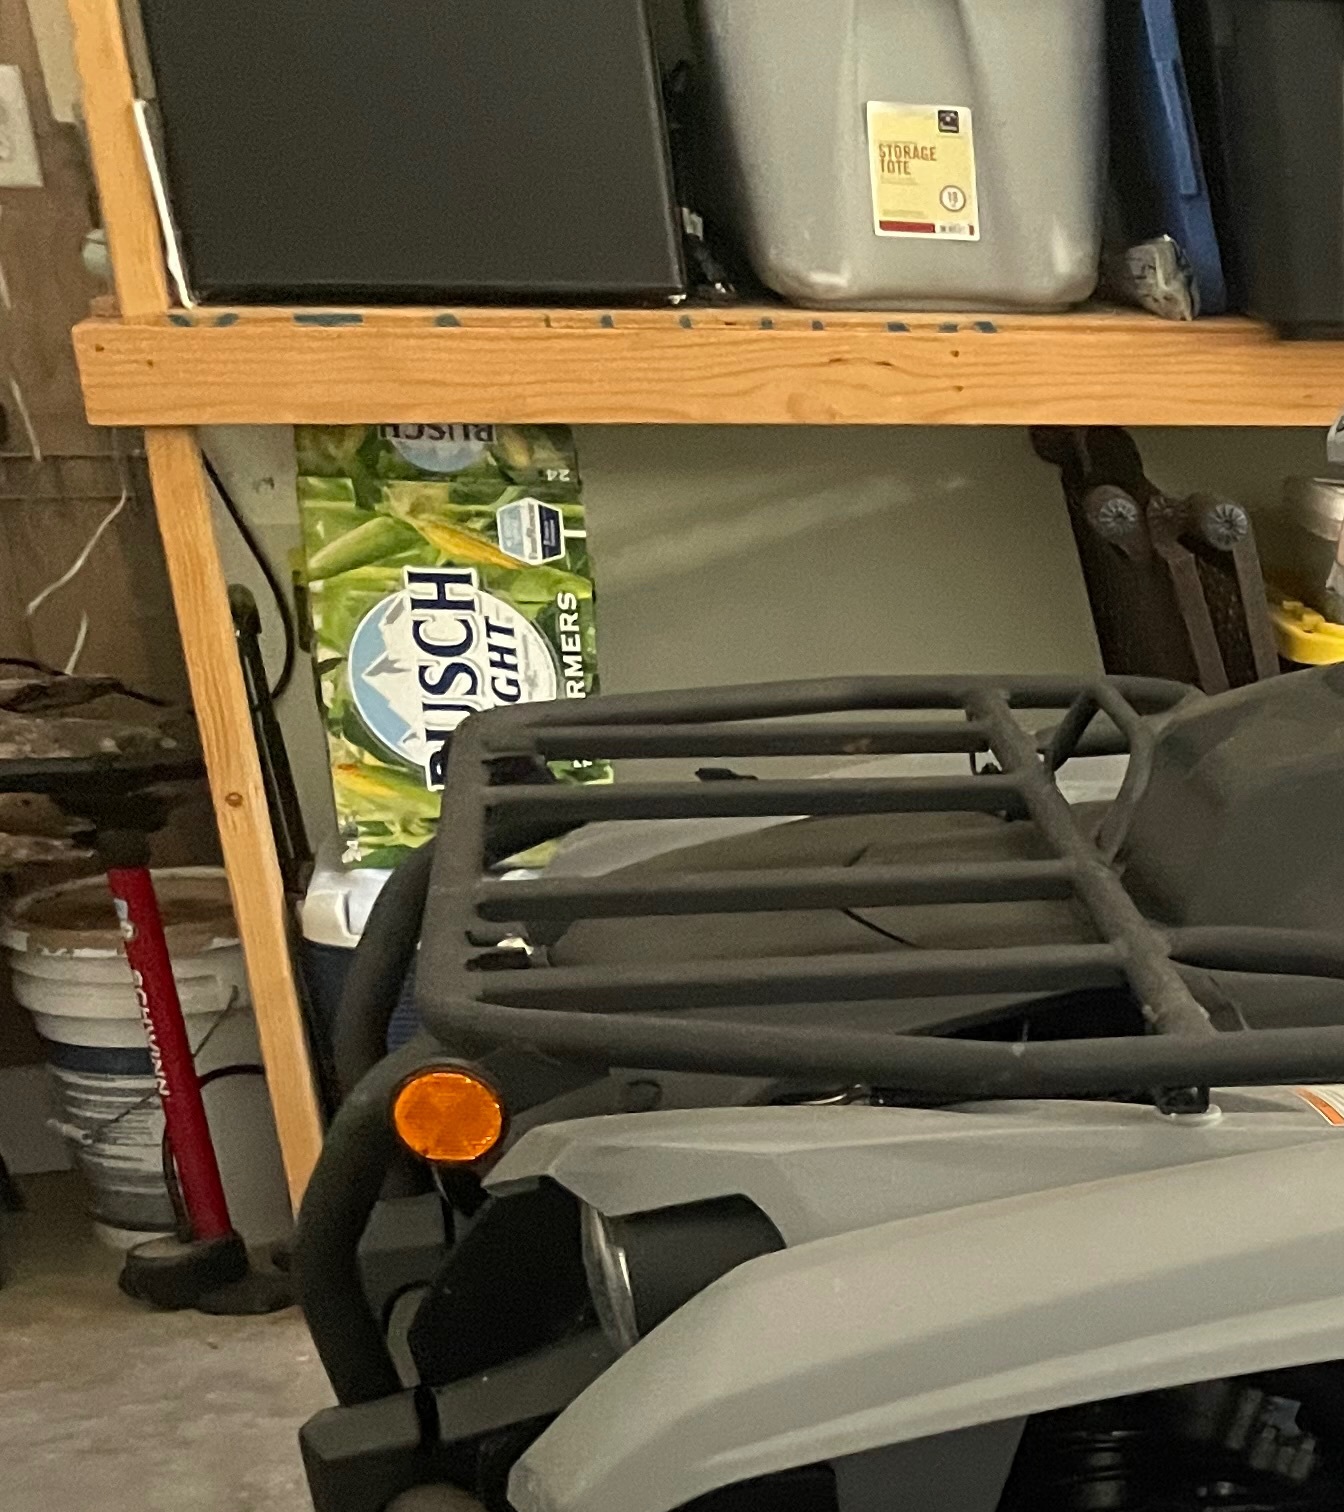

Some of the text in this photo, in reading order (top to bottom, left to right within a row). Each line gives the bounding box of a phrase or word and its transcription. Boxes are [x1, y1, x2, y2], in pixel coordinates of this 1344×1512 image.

[879, 143, 937, 161] STORAGE
[880, 159, 912, 175] TOTE
[546, 468, 571, 482] 24
[484, 615, 522, 703] GHT
[557, 591, 587, 699] RMERS
[407, 570, 480, 786] USCH
